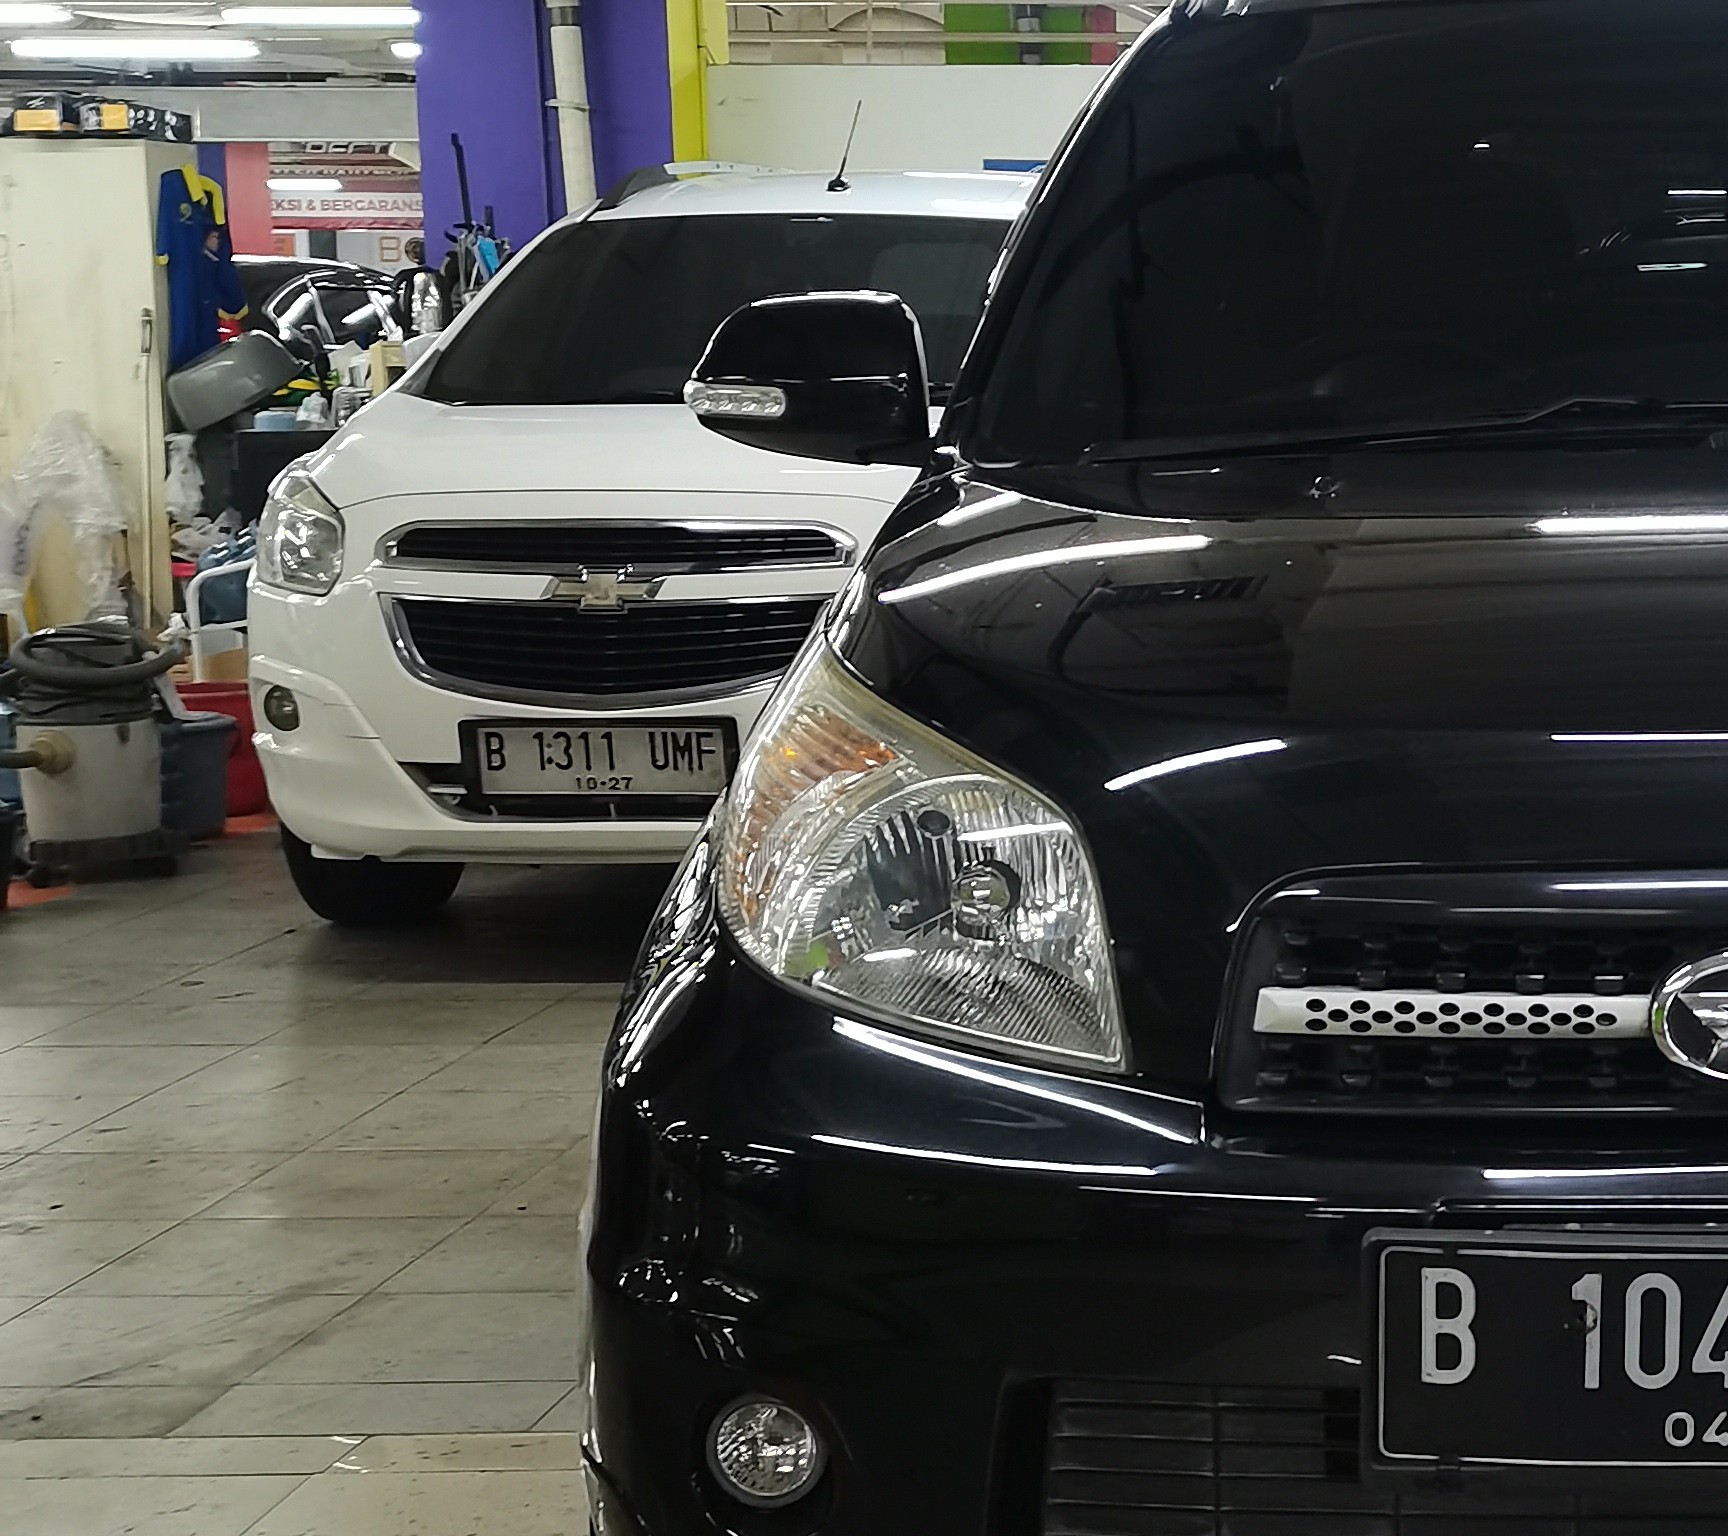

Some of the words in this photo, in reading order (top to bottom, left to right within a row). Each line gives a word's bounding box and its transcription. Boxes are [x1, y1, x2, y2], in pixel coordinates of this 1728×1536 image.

[485, 732, 506, 771] B
[532, 731, 617, 771] 1311
[648, 731, 716, 773] UMF
[1420, 1267, 1477, 1384] B
